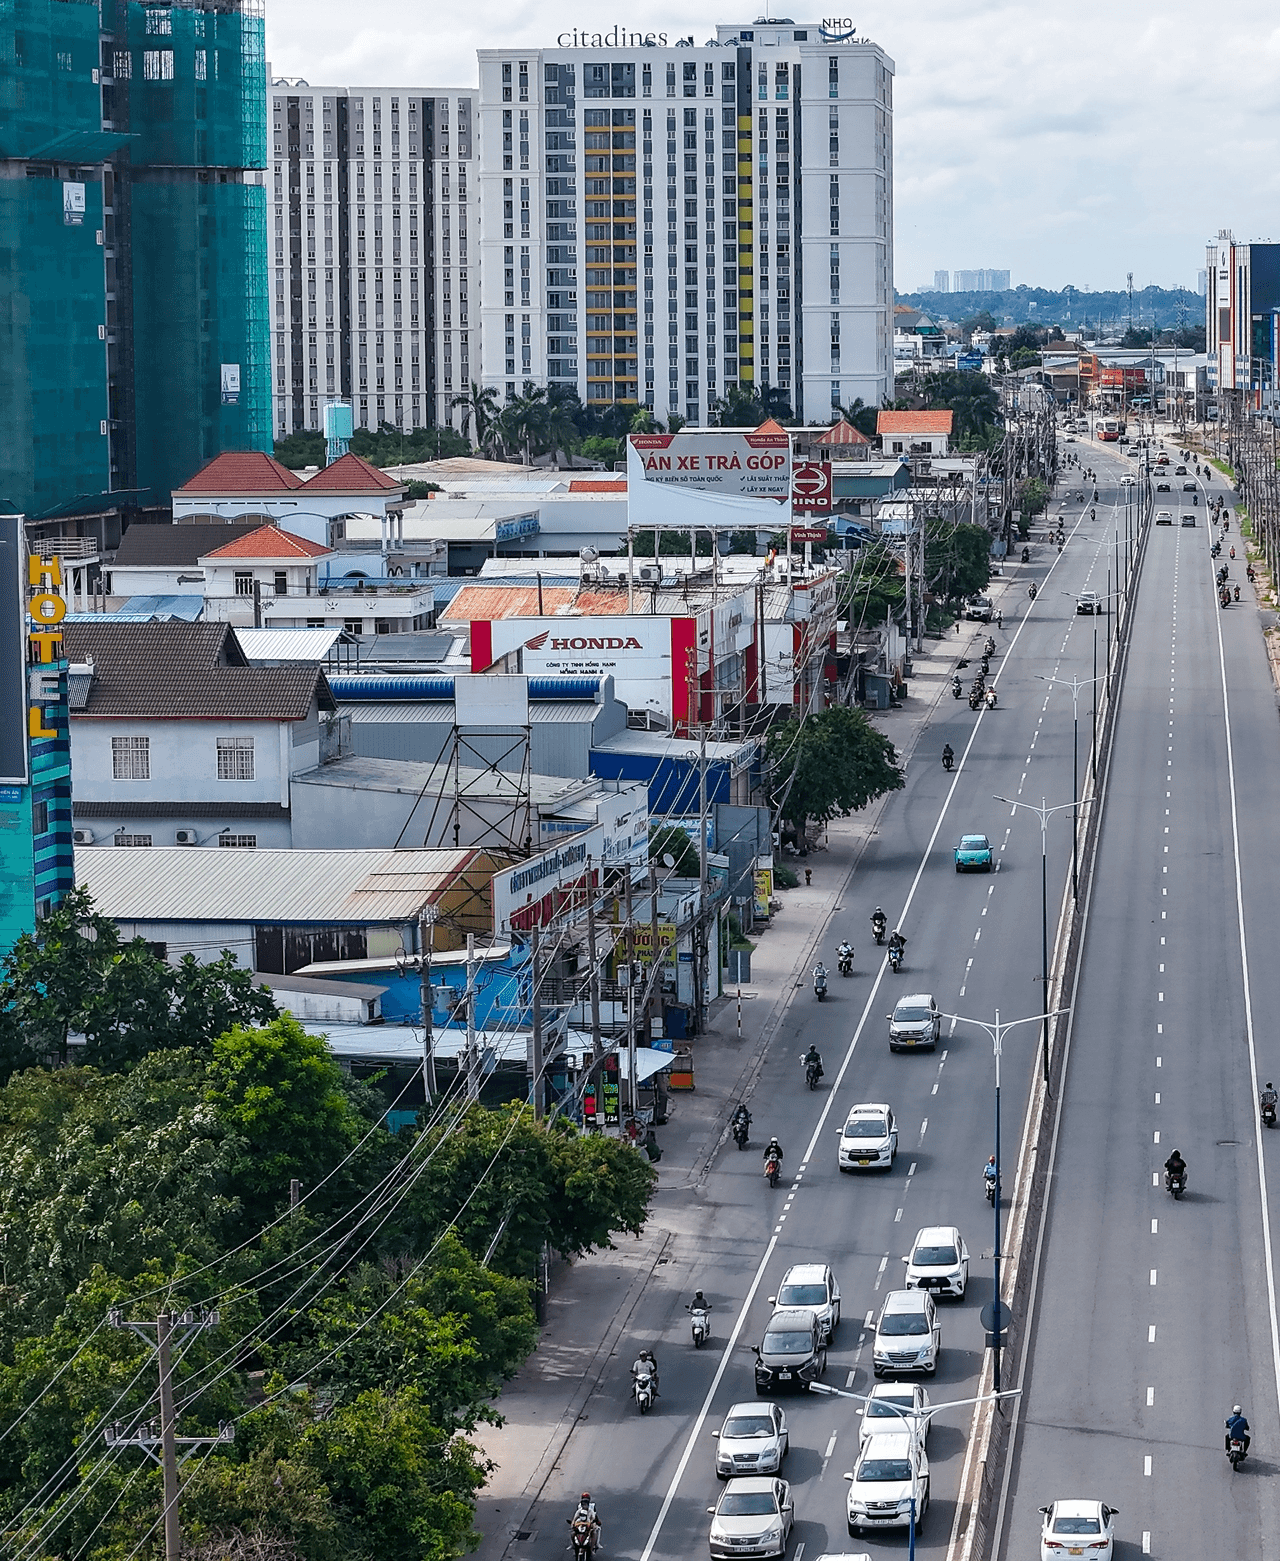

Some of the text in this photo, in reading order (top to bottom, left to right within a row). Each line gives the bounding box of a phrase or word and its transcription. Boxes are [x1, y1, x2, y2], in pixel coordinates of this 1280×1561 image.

[557, 24, 668, 47] citadines
[677, 455, 699, 470] XE
[705, 451, 741, 470] TRẢ
[746, 451, 786, 470] GÓP
[29, 555, 66, 737] HOTEL
[550, 637, 643, 650] HONDA
